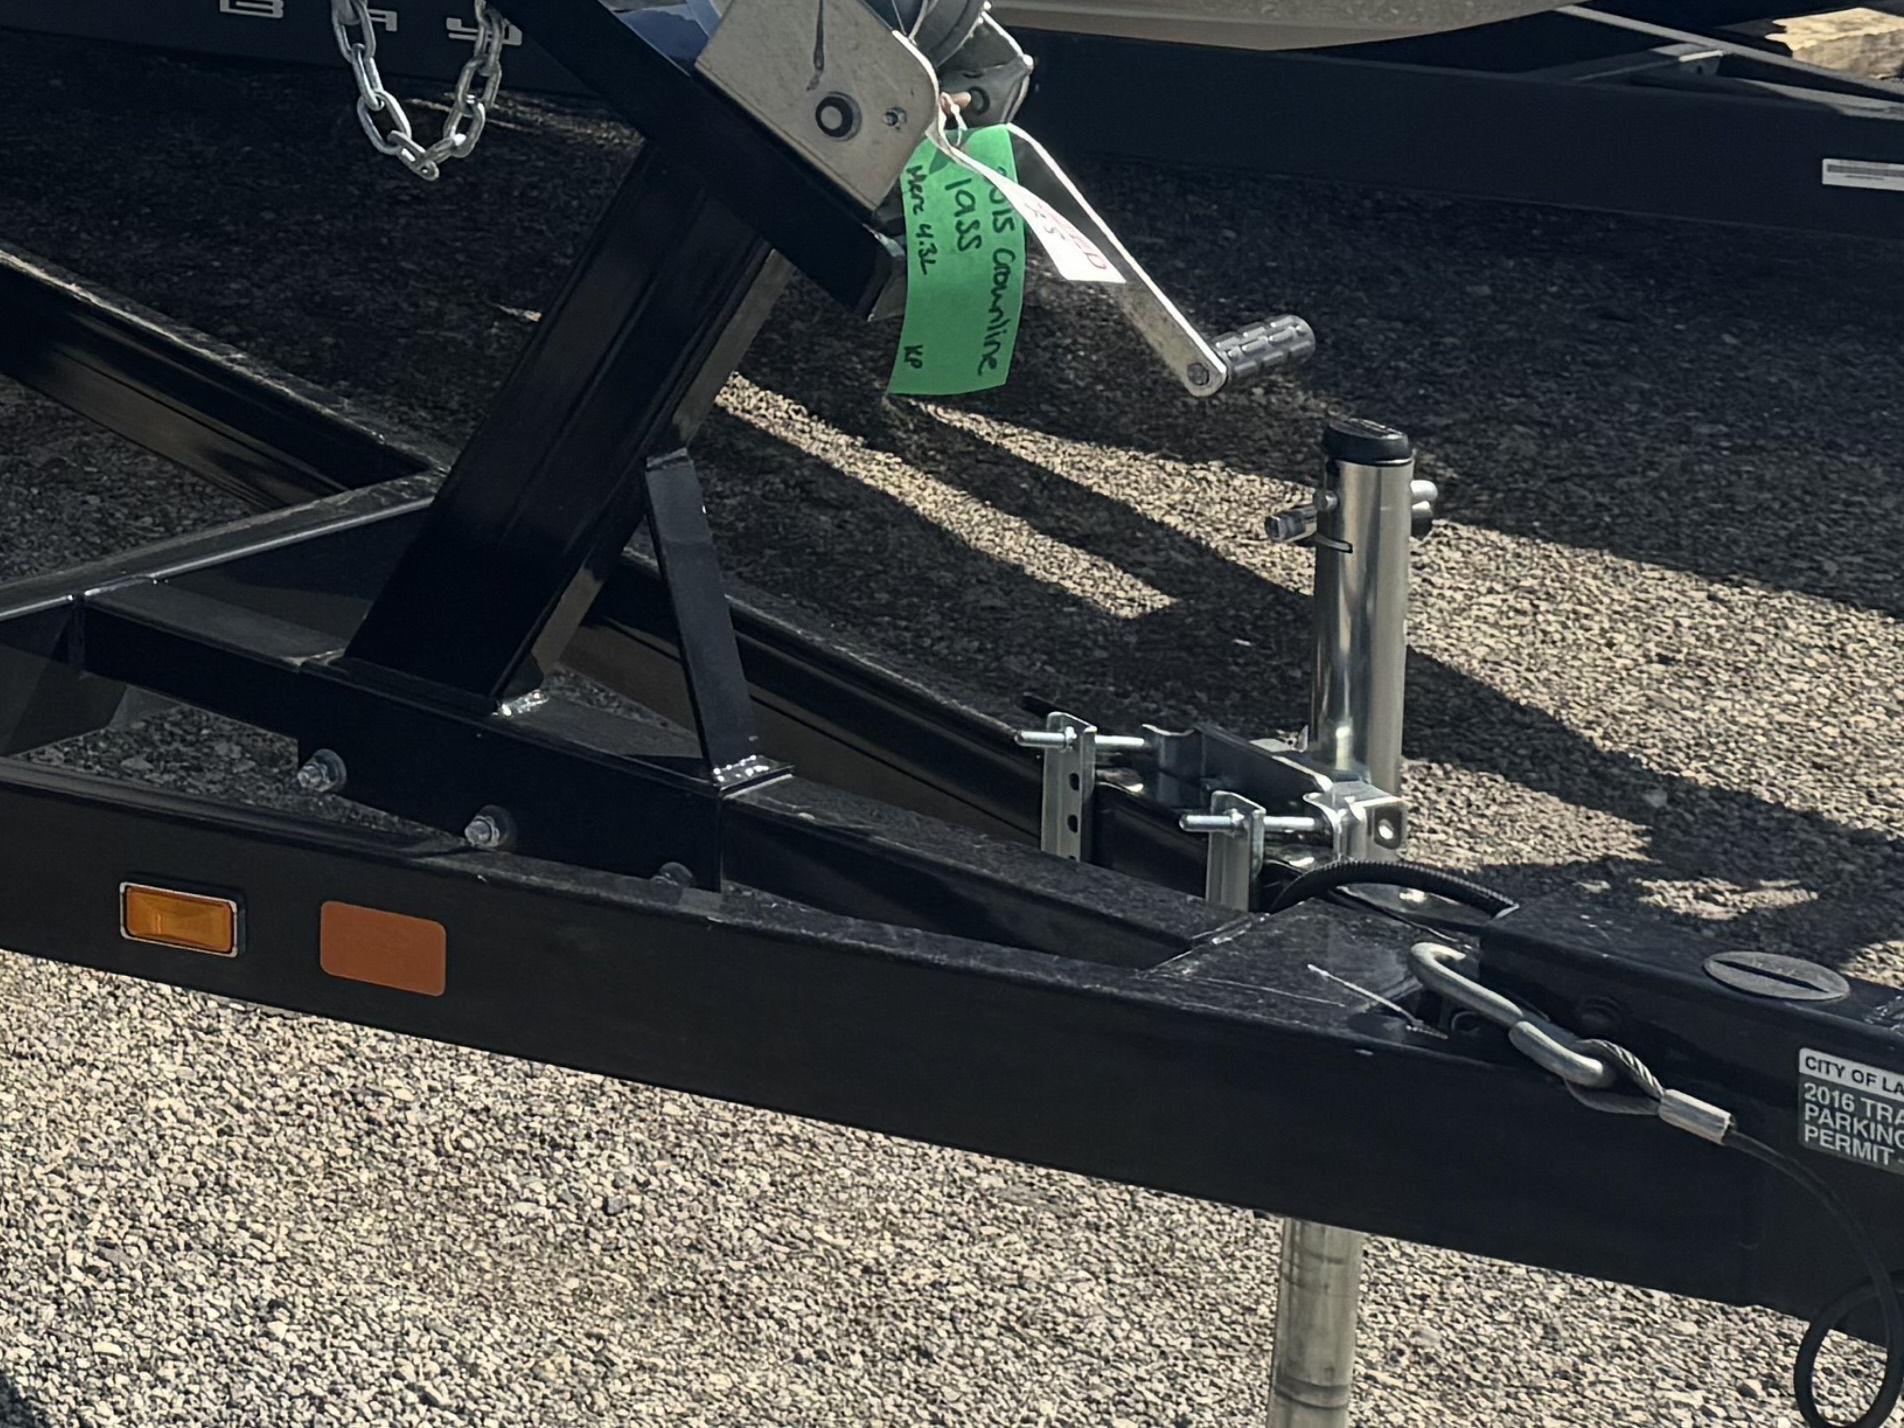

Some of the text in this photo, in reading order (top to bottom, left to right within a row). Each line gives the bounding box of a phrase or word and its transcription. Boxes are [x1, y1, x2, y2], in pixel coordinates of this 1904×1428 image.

[1804, 1055, 1846, 1079] CITY
[1850, 1069, 1878, 1086] OF
[1803, 1082, 1856, 1113] 2016
[1804, 1123, 1895, 1166] PERMIT
